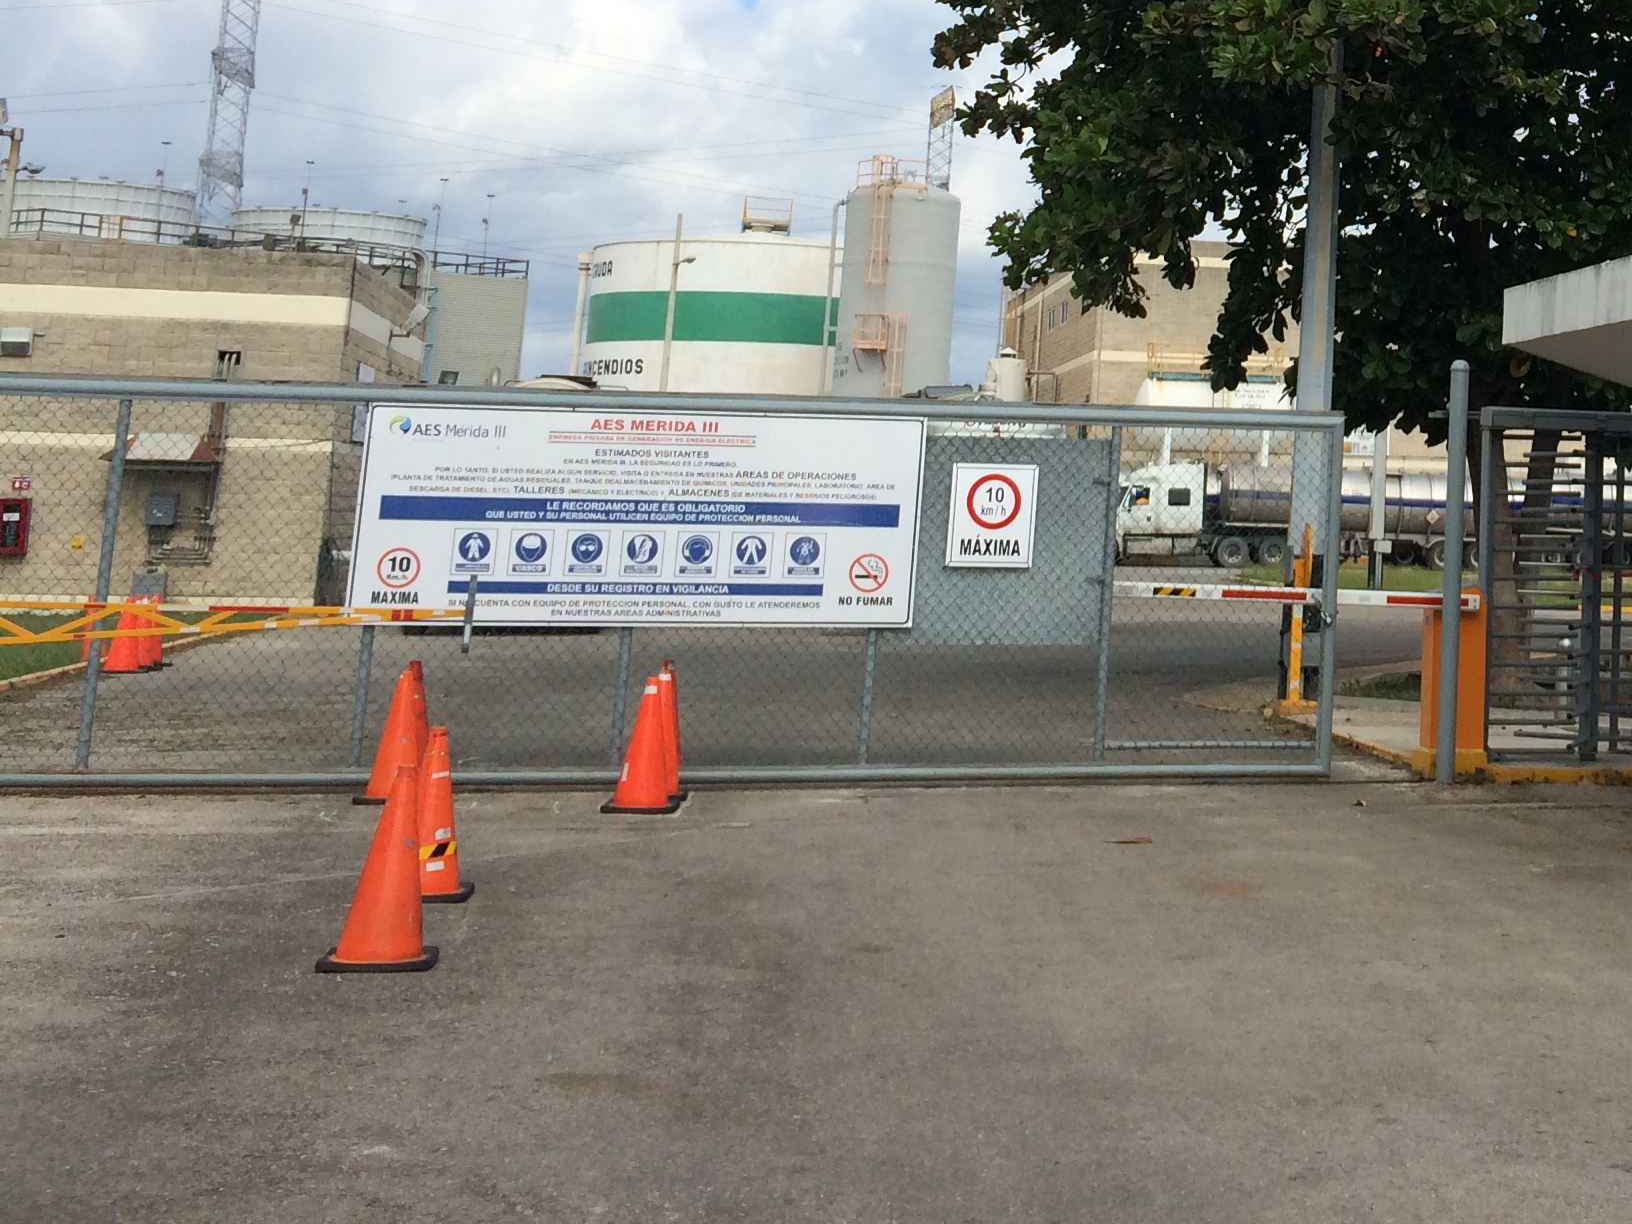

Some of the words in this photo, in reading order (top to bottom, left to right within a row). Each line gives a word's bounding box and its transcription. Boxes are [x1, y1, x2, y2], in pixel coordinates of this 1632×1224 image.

[412, 424, 442, 436] AES
[494, 425, 506, 438] III
[590, 418, 625, 431] AES
[630, 420, 697, 433] MERIDA
[702, 421, 719, 433] III
[595, 448, 652, 458] ESTIMADOS
[655, 450, 709, 459] VISITANTES
[735, 470, 769, 479] AREAS
[771, 471, 785, 479] DE
[787, 471, 857, 480] OPERACIONES
[514, 486, 565, 495] TALLERES
[668, 489, 730, 497] ALMACENES
[986, 487, 1004, 503] 10
[546, 501, 559, 510] LE
[562, 502, 635, 511] RECORDAMOS
[638, 502, 660, 512] QUE
[662, 503, 675, 512] ES
[678, 503, 745, 513] OBLIGATORIO
[485, 510, 504, 519] QUE
[507, 511, 536, 519] USTED
[539, 511, 545, 519] Y
[560, 512, 607, 520] PERSONAL
[651, 513, 683, 522] EQUIPO
[699, 514, 754, 522] PROTECCION
[756, 514, 801, 523] PERSONAL
[960, 534, 1020, 556] MÁXIMA
[388, 556, 411, 573] 10
[547, 583, 582, 593] DESDE
[584, 583, 599, 593] SU
[601, 584, 653, 594] REGISTRO
[656, 584, 669, 594] EN
[672, 584, 729, 594] VIGILANCIA
[371, 591, 419, 604] MAXIMA
[838, 596, 852, 606] NO
[856, 596, 893, 606] FUMAR
[475, 599, 509, 607] CUENTA
[533, 600, 567, 608] EQUIPO
[583, 600, 639, 608] PROTECCION
[757, 601, 821, 609] ATENDEREMOS
[565, 609, 612, 617] NUESTRAS
[645, 610, 721, 618] ADMINISTRATIVAS
